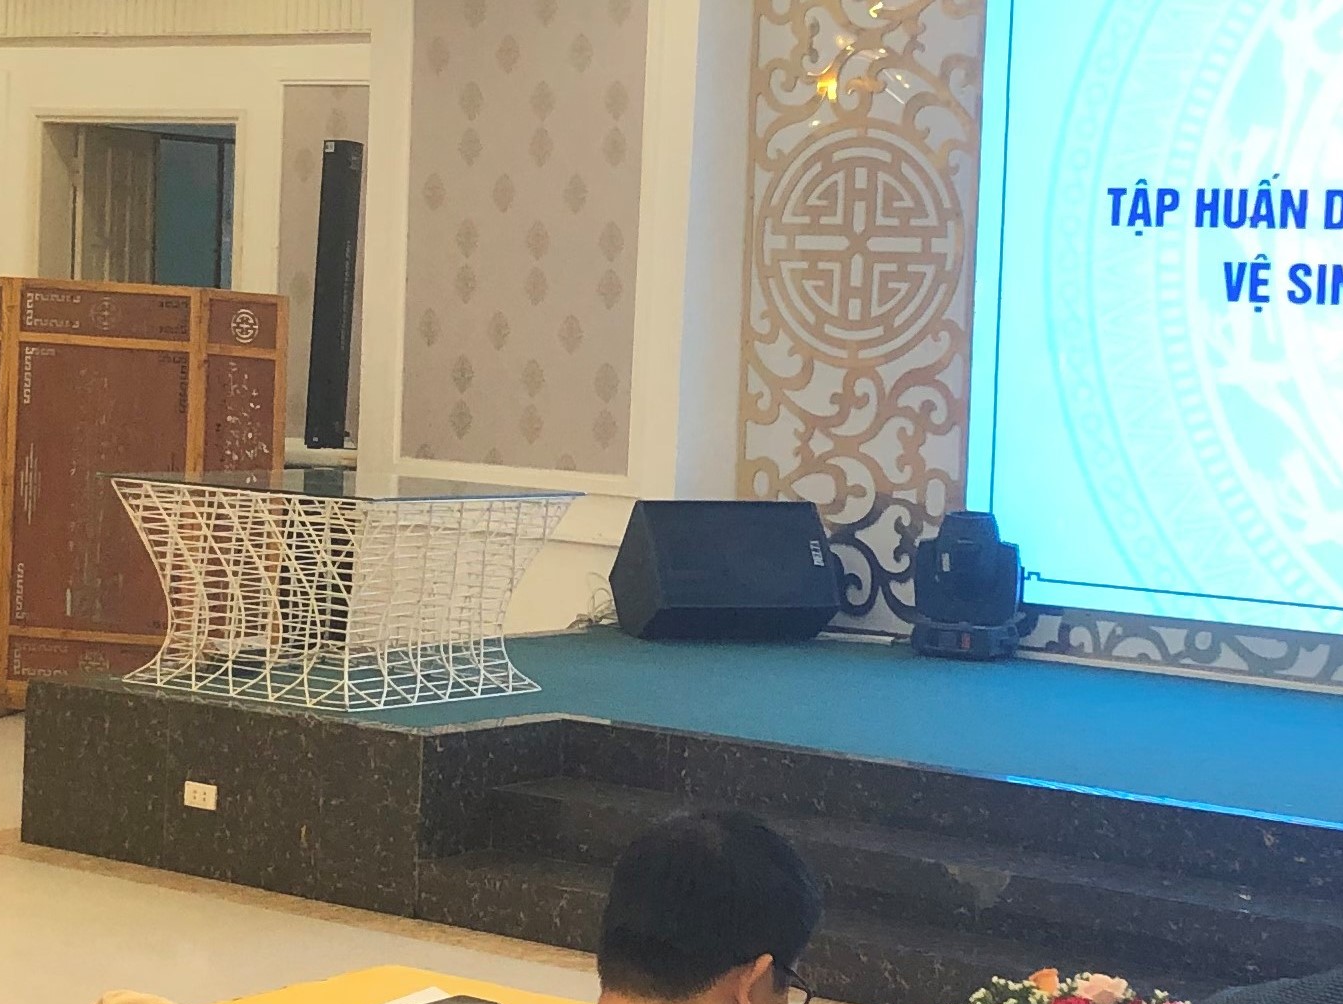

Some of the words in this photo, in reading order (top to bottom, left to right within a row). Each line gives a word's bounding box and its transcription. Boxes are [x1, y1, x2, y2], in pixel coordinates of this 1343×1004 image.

[1107, 178, 1181, 237] TẬP
[1194, 174, 1309, 230] HUẤN
[1223, 253, 1271, 312] VỆ
